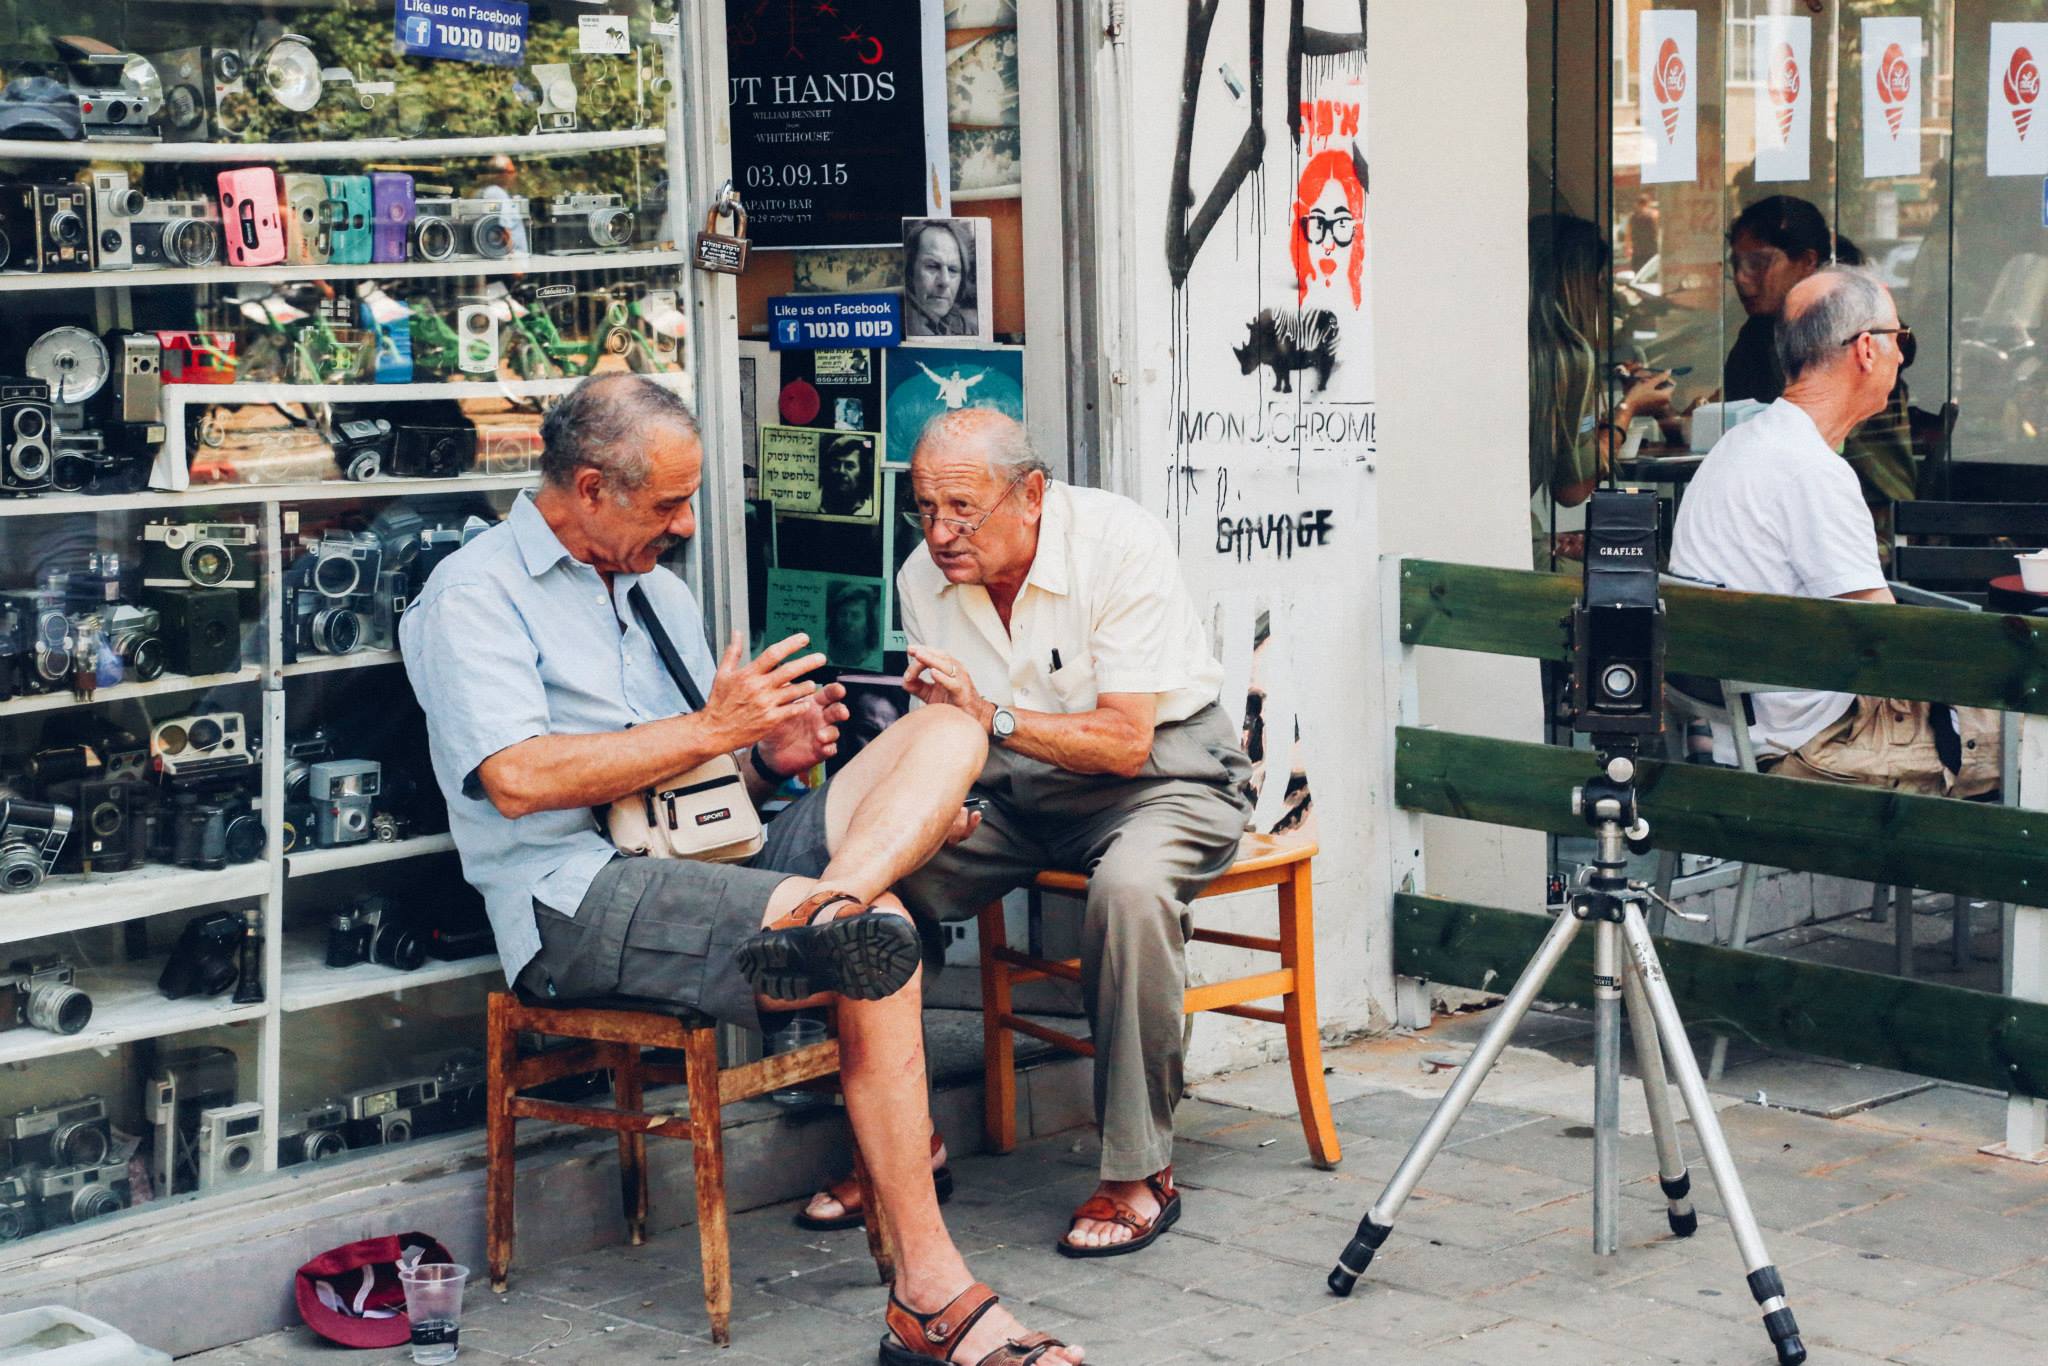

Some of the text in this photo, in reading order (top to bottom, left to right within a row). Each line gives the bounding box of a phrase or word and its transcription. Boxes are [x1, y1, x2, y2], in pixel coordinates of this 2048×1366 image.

[404, 0, 521, 26] Like us on Facebook
[436, 24, 521, 53] פוטו סנטר
[772, 71, 896, 104] HANDS
[752, 109, 832, 120] WILLIAM BENNETT
[746, 162, 848, 188] 03.09.15
[789, 198, 812, 210] BAR
[775, 302, 891, 316] Like us on Facebook
[804, 320, 893, 339] פוטו סנטר
[1600, 547, 1644, 556] GRAFLEX
[703, 811, 724, 821] SPORT
